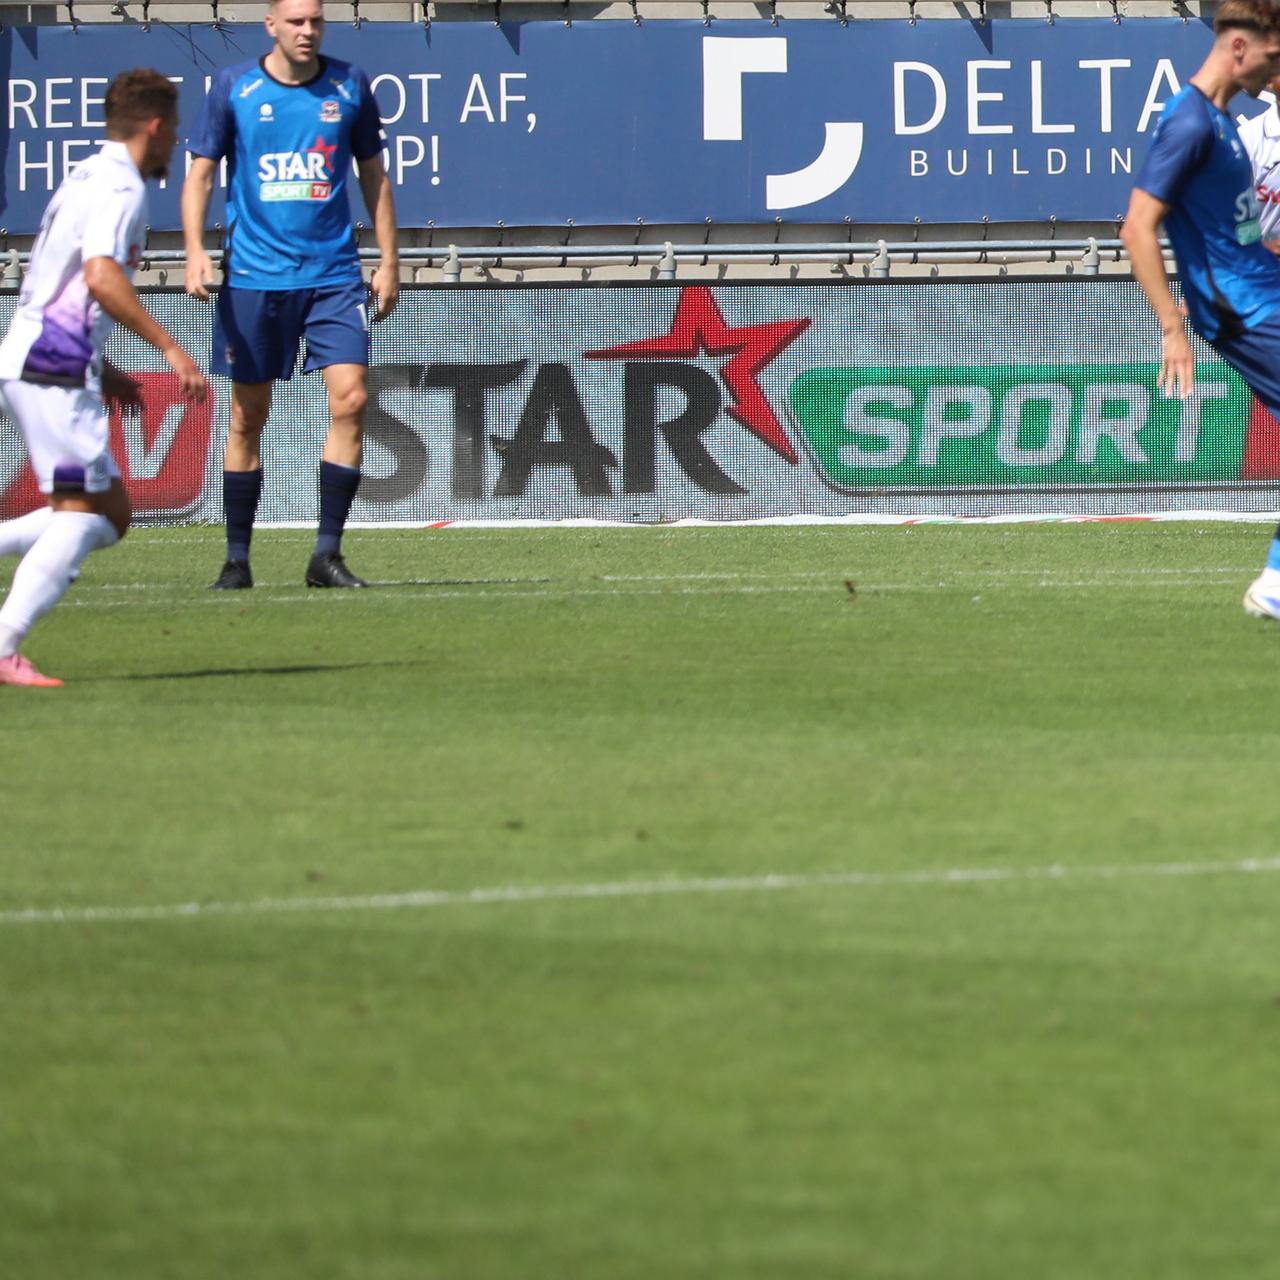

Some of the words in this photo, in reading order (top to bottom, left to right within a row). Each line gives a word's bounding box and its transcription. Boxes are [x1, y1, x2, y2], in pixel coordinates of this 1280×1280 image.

[459, 72, 537, 133] AF,
[893, 58, 1181, 136] DELTA
[258, 151, 328, 181] STAR
[910, 146, 1133, 177] BUILDIN
[262, 183, 310, 199] SPORT
[312, 184, 329, 198] TV
[356, 358, 749, 503] STAR
[840, 382, 1228, 469] SPORT
